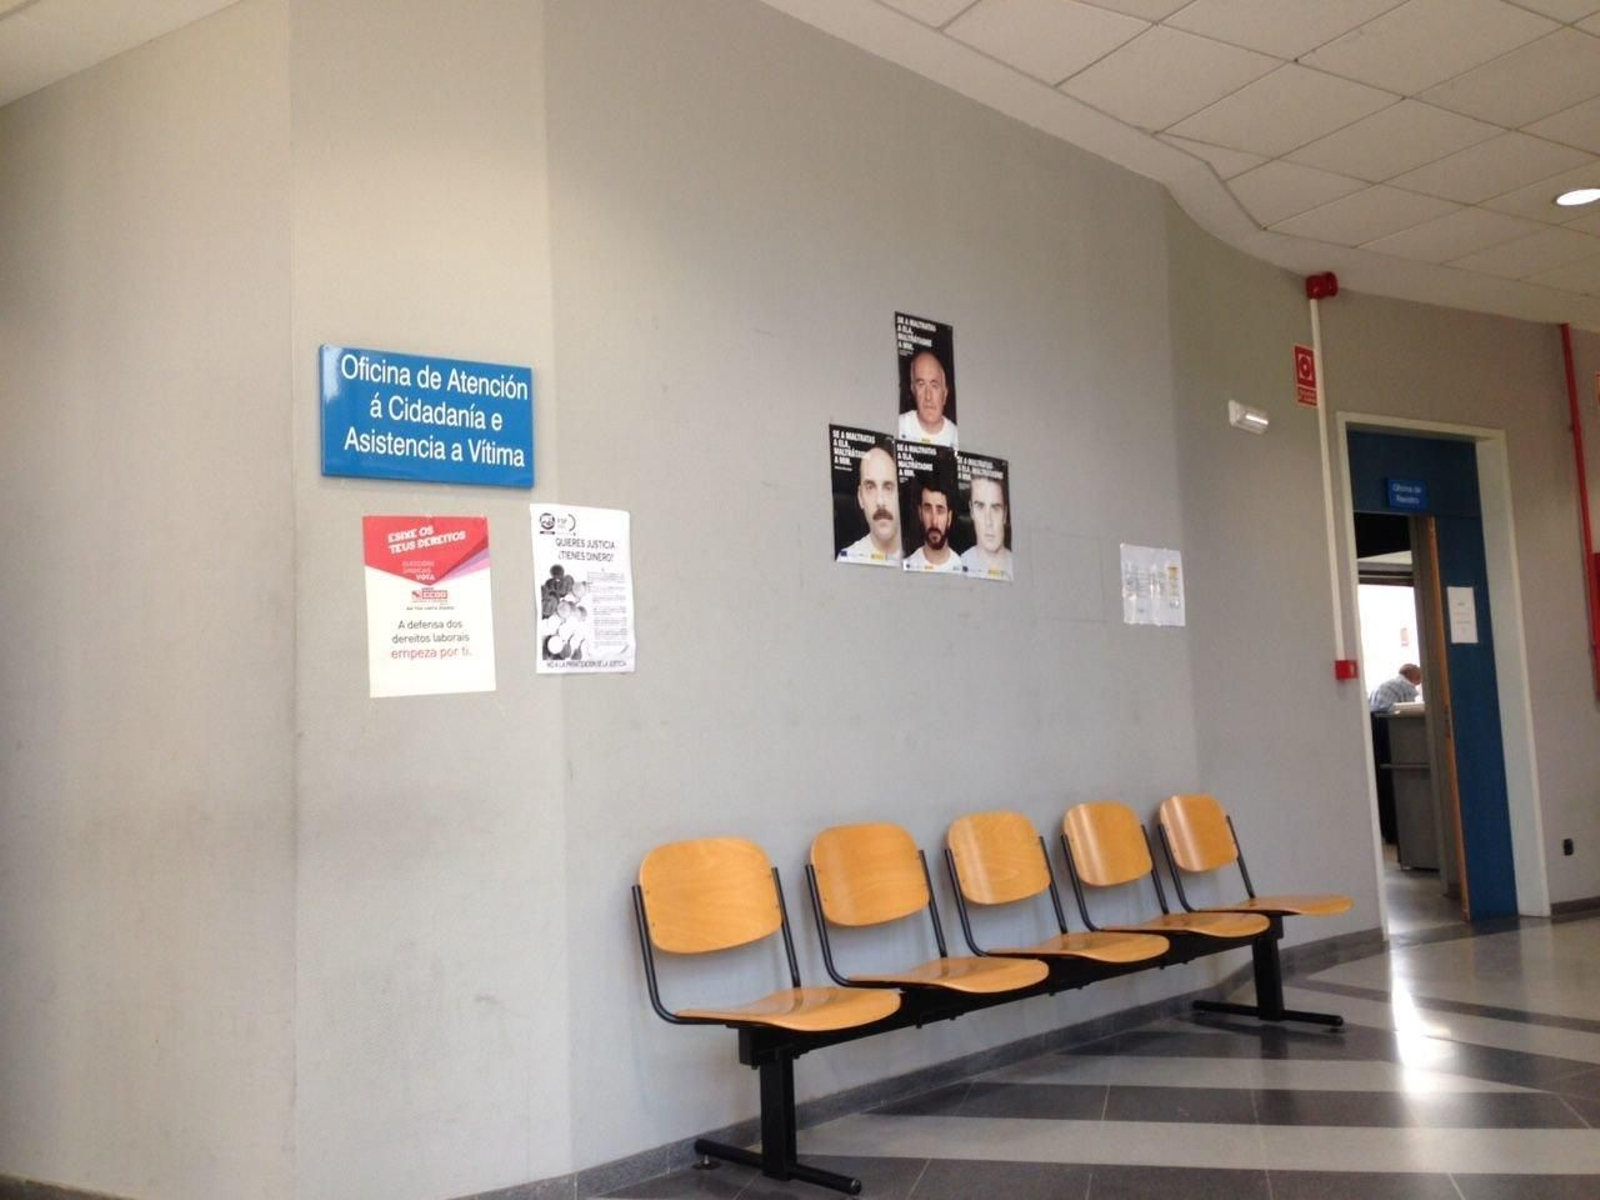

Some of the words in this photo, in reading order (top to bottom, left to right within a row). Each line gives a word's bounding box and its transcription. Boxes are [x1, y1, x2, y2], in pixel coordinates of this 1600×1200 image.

[341, 354, 411, 386] Oficina
[417, 365, 442, 390] de
[447, 368, 528, 400] Atención
[370, 392, 382, 418] á
[388, 395, 486, 429] Cidadanía
[491, 413, 503, 431] e
[833, 429, 840, 439] SE
[846, 431, 875, 444] MALTRATAS
[344, 426, 446, 460] Asistencia
[451, 443, 463, 461] a
[468, 438, 525, 467] Vítima
[419, 526, 434, 537] OS
[388, 540, 416, 554] TEUS
[417, 530, 466, 549] DEREITOS
[556, 538, 585, 548] QUIERES
[586, 539, 615, 549] JUSTICIA
[398, 620, 405, 630] A
[407, 620, 444, 630] defensa
[446, 619, 463, 629] dos
[392, 634, 430, 644] dereitos
[433, 633, 470, 642] laborais
[391, 649, 437, 660] empeza
[440, 648, 458, 659] por
